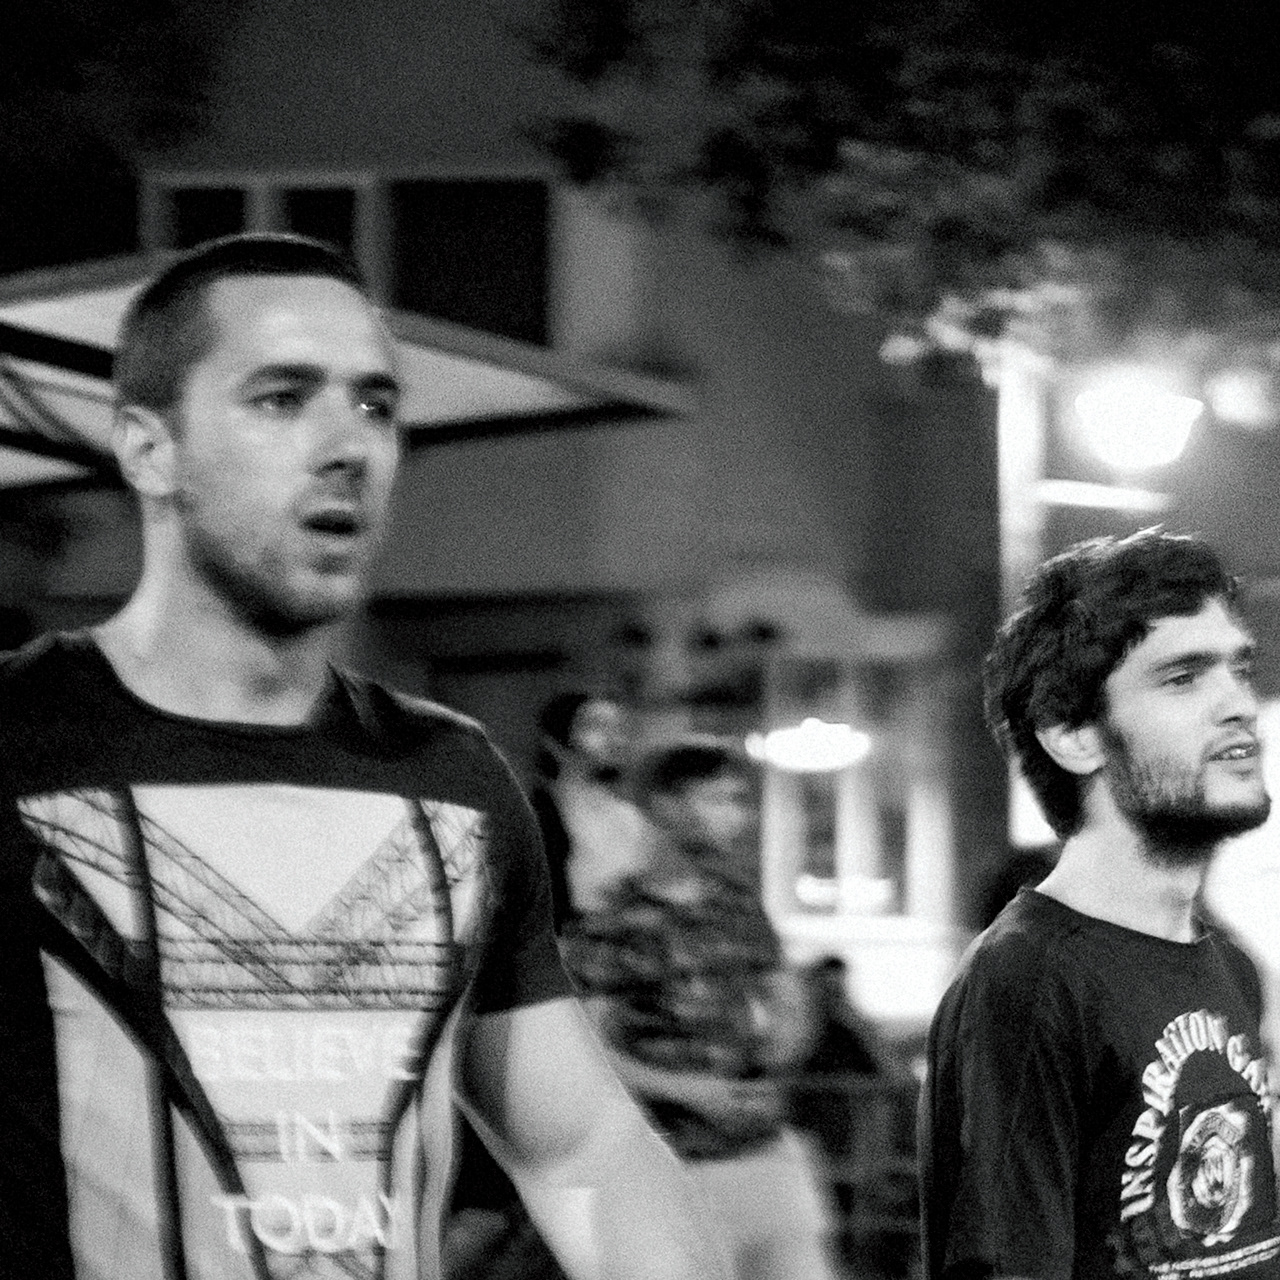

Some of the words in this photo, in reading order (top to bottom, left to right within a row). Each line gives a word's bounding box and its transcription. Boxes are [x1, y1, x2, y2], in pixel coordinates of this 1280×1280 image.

[190, 1025, 420, 1081] BELIEVE
[276, 1109, 344, 1163] IN
[1120, 1008, 1230, 1223] INSPIRATION
[210, 1193, 403, 1256] TODAY
